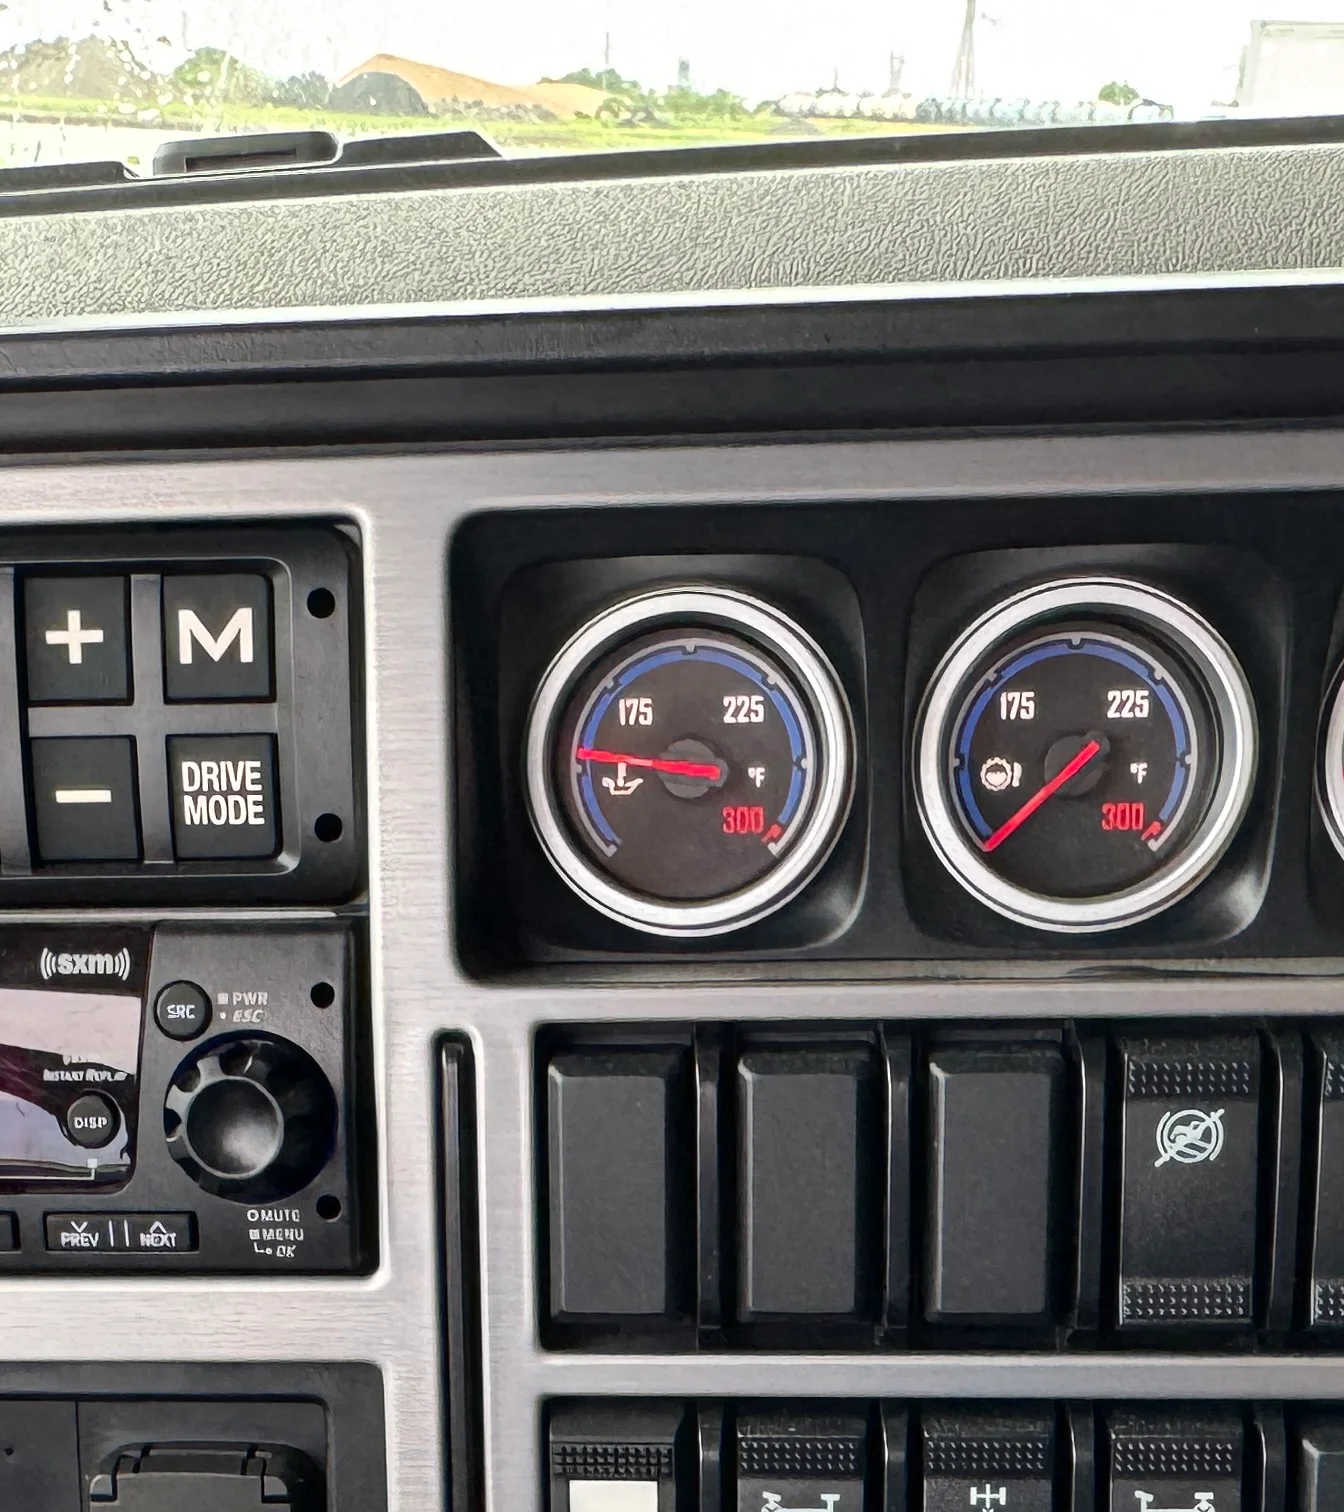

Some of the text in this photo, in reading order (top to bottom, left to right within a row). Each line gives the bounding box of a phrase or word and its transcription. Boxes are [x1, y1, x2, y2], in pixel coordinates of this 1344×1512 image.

[178, 607, 254, 664] M
[618, 695, 765, 726] 175 225
[1000, 690, 1150, 720] 175 225
[181, 760, 263, 796] DRIVE
[183, 794, 265, 826] MODE
[722, 806, 764, 834] 300
[1102, 803, 1144, 830] 300
[167, 1004, 195, 1019] SRC
[232, 992, 268, 1006] PWR
[233, 1009, 264, 1023] ESC
[74, 1117, 108, 1129] DISP
[61, 1232, 176, 1248] PREV NEXT
[262, 1228, 304, 1241] MENU
